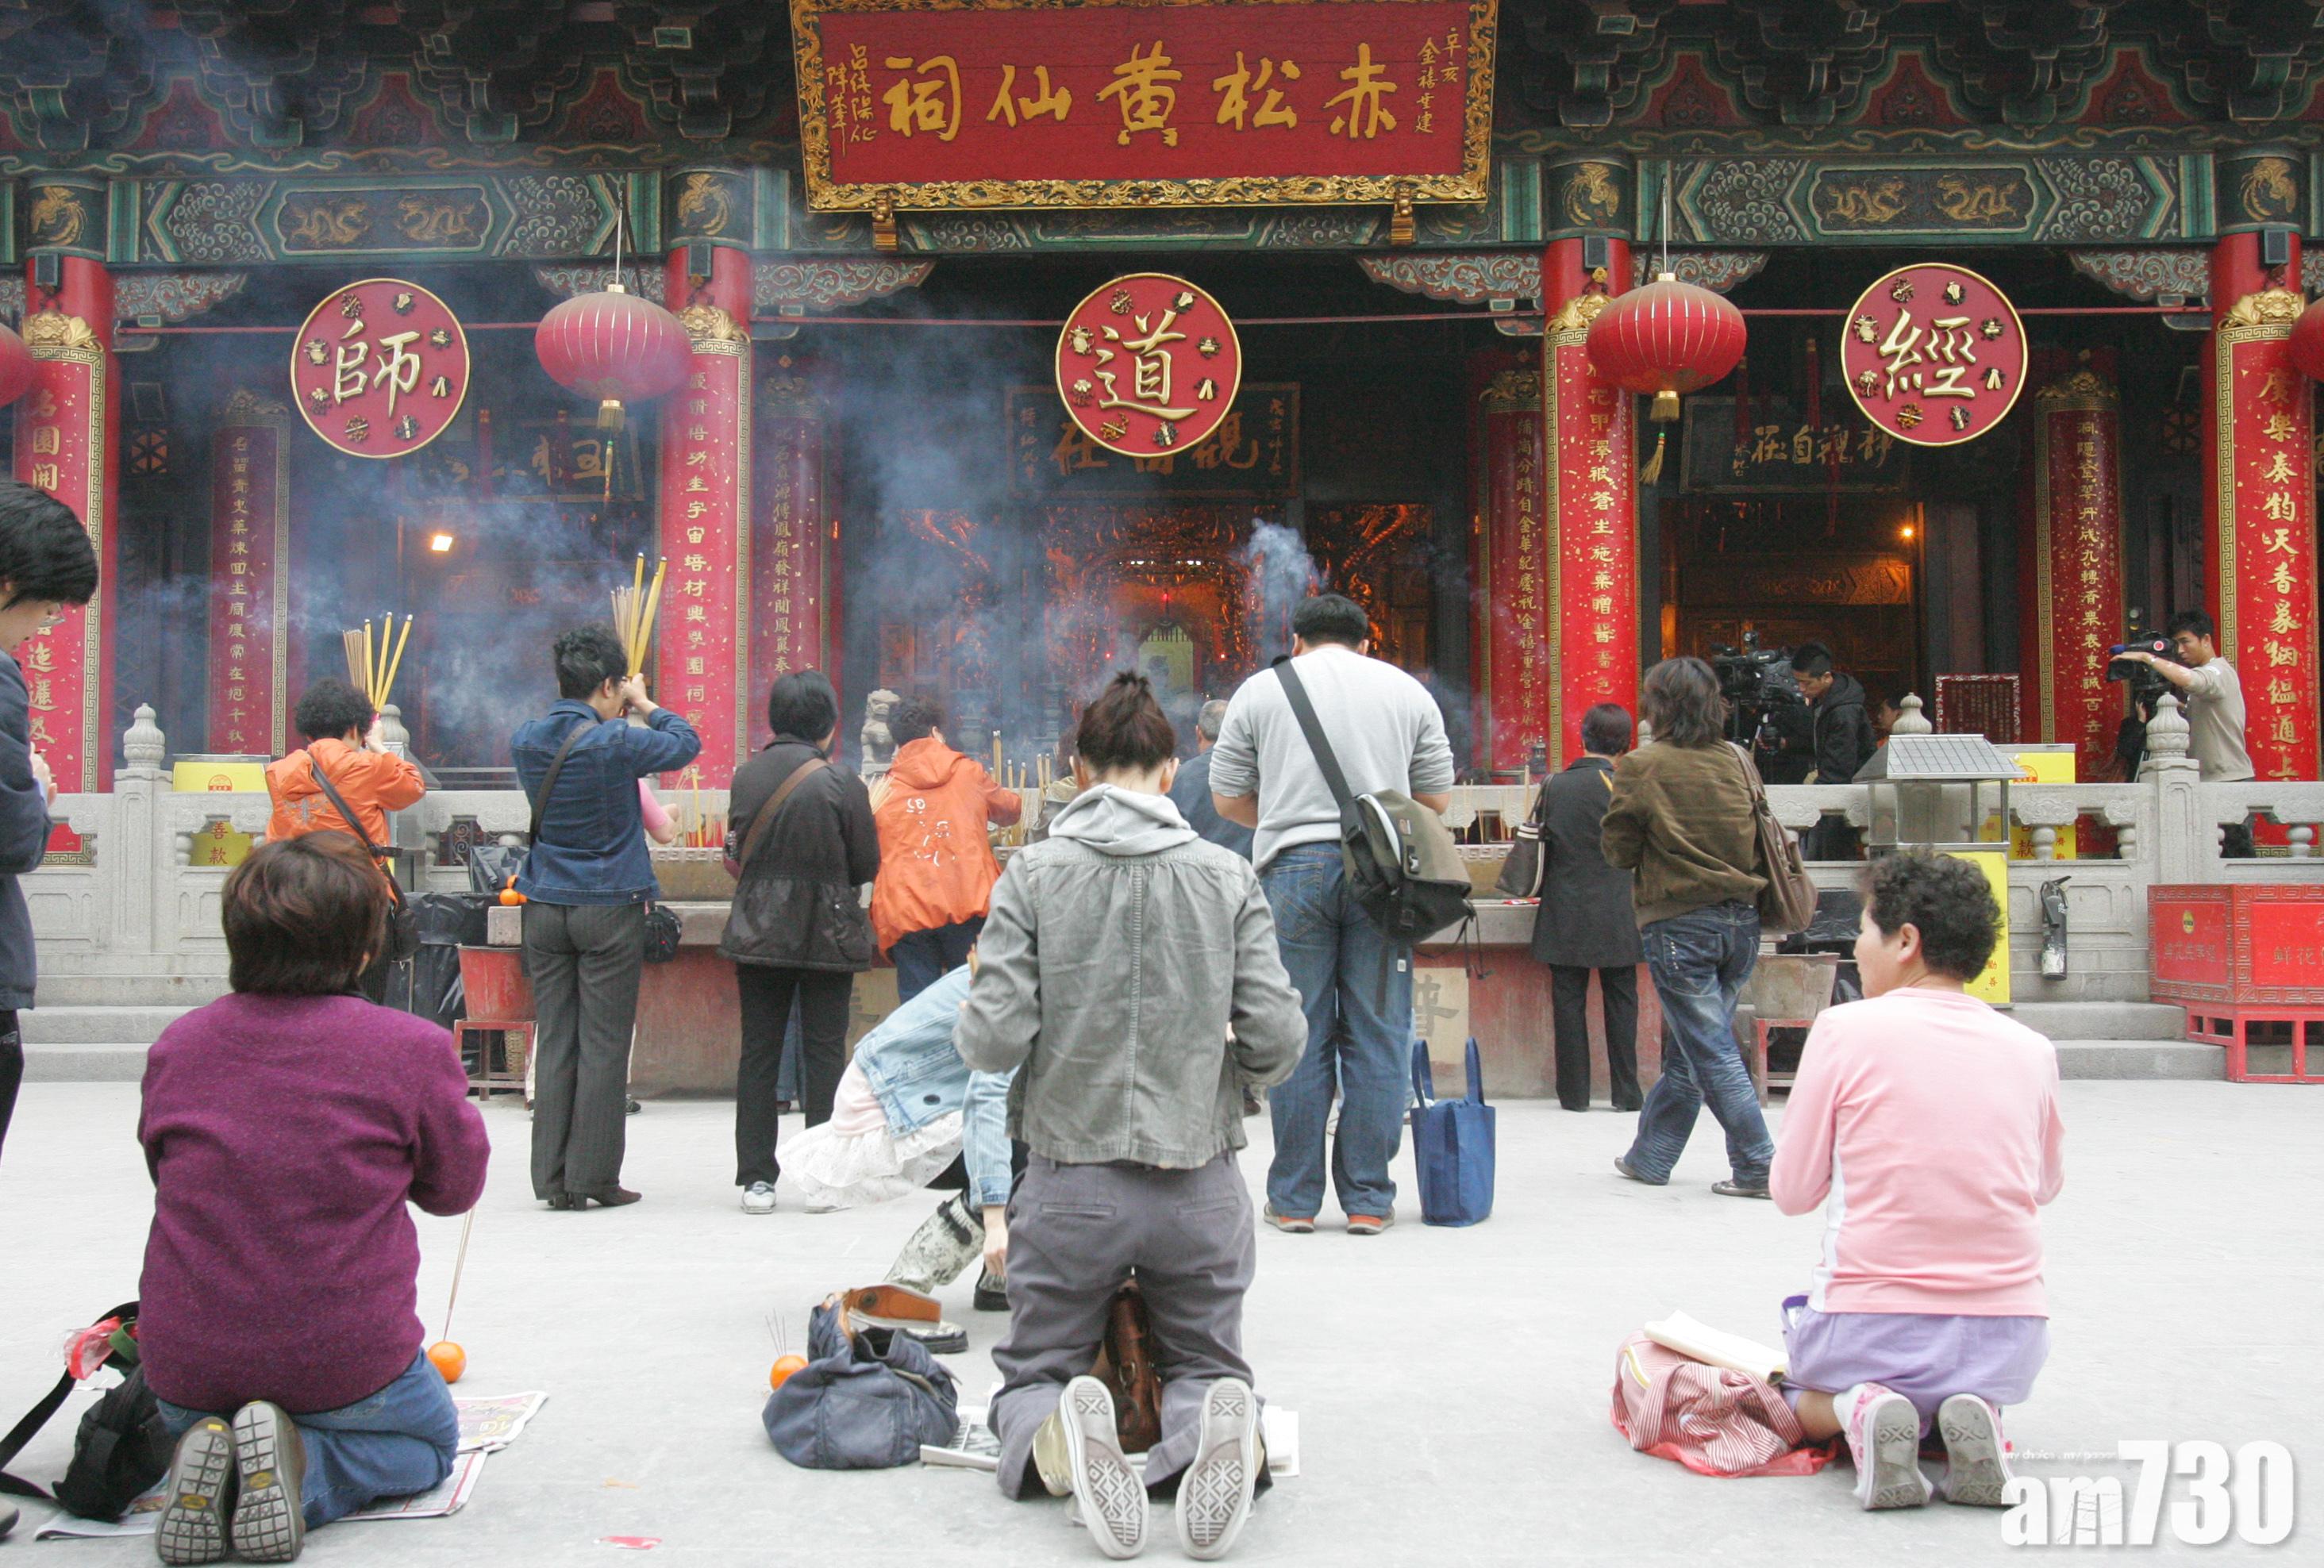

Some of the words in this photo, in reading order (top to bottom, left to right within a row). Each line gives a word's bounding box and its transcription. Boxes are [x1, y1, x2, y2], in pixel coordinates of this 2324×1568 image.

[882, 40, 1399, 147] 赤松黃仙祠
[335, 319, 424, 418] 師
[1093, 309, 1199, 419] 道
[1878, 307, 1979, 401] 經
[210, 821, 229, 865] 善款
